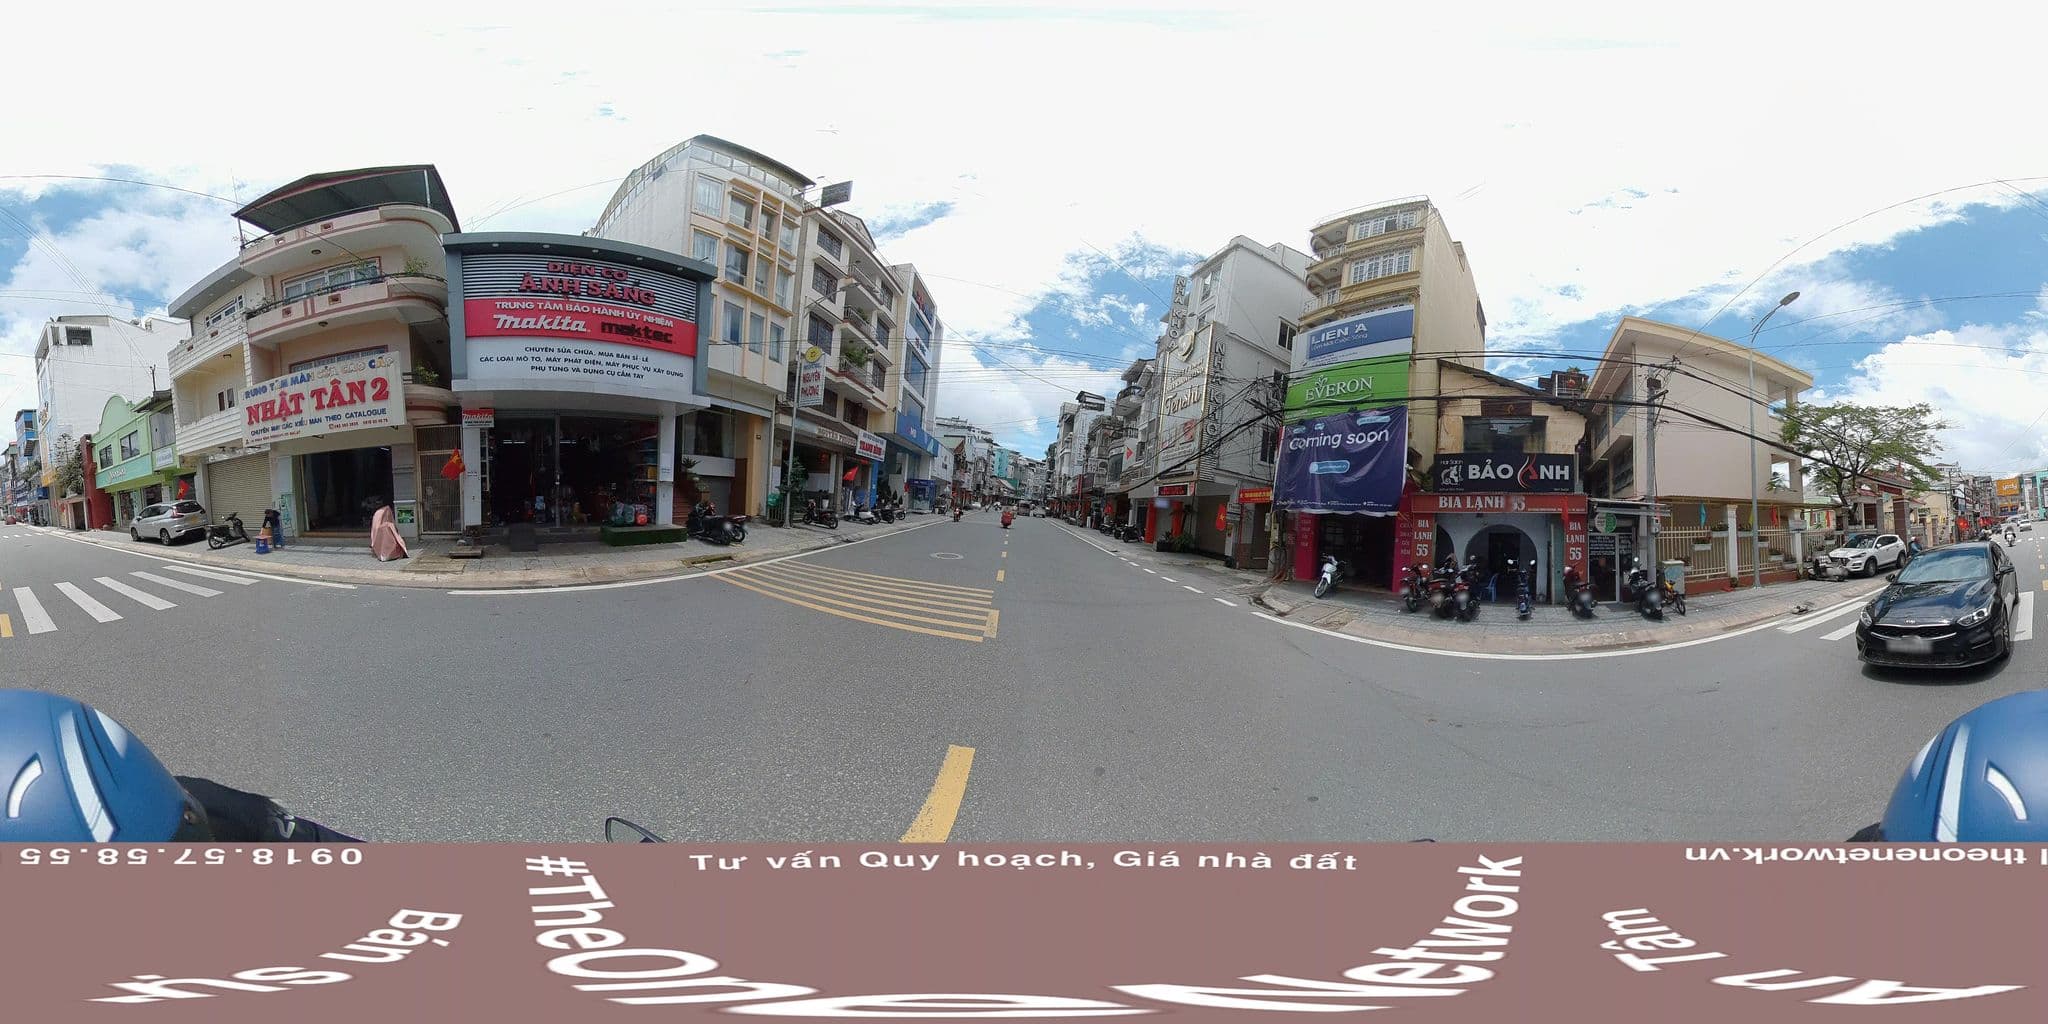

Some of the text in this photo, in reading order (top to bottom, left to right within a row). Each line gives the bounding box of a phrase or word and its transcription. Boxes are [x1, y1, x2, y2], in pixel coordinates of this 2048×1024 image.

[547, 262, 596, 276] ĐIỆN
[587, 280, 656, 305] SÁNG
[495, 302, 535, 310] TRUNG
[537, 301, 563, 311] TÂM
[565, 303, 590, 313] BẢO
[592, 306, 625, 318] HÀNH
[643, 314, 674, 328] NHIỆM
[1166, 279, 1187, 350] NHA KHOA
[1311, 326, 1350, 345] LIEN
[616, 352, 630, 360] BÁN
[548, 364, 569, 373] TÙNG
[564, 356, 582, 364] PHÁT
[653, 367, 664, 375] XÂY
[1306, 376, 1374, 401] EVERON
[246, 376, 390, 426] NHẬT TÂN 2
[1165, 385, 1201, 416] Tenshi
[325, 413, 342, 422] THEO
[345, 407, 387, 420] CATALOGUE
[1346, 429, 1389, 445] soon
[1468, 458, 1514, 480] BẢO
[1439, 495, 1462, 509] BIA
[1466, 495, 1505, 511] LẠNH
[1418, 519, 1429, 528] BIA
[1569, 521, 1581, 531] BIA
[1414, 531, 1432, 542] LẠNH
[1566, 534, 1585, 544] LẠNH
[1416, 543, 1429, 557] 55
[1569, 547, 1582, 561] 55
